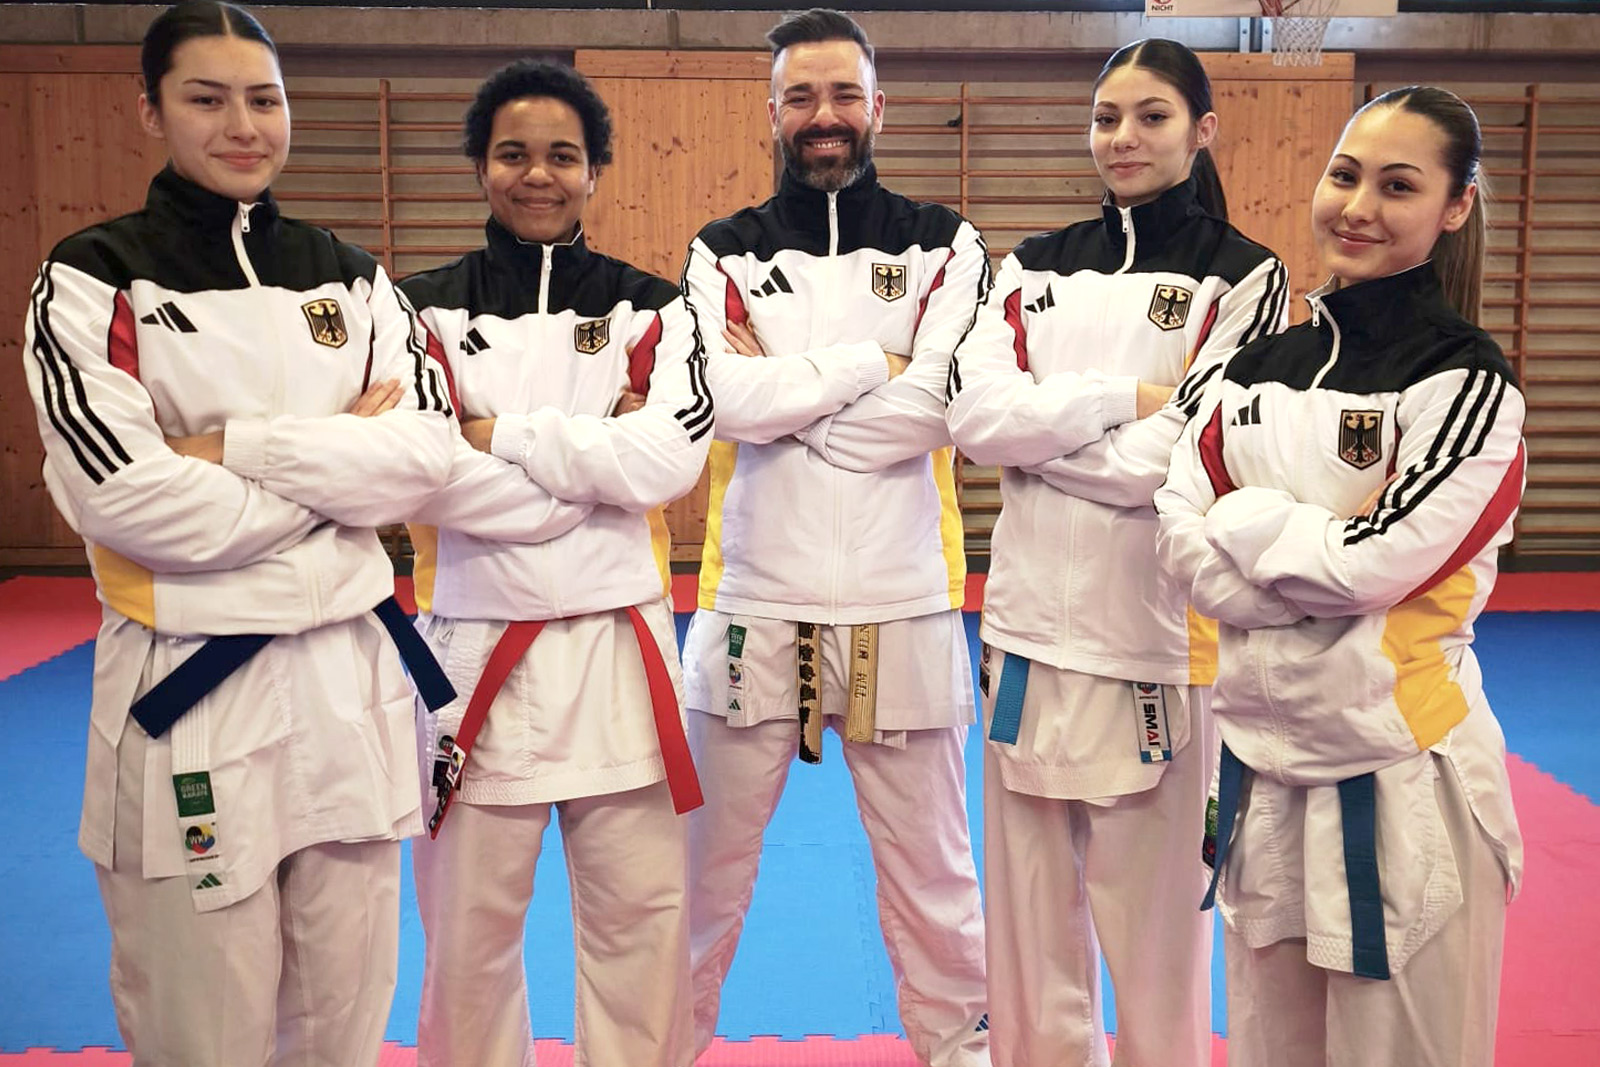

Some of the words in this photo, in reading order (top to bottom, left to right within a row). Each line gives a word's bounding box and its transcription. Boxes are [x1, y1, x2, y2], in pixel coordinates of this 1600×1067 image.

[854, 672, 867, 698] TIM
[1143, 703, 1161, 746] SMAI
[180, 783, 208, 792] GREEN
